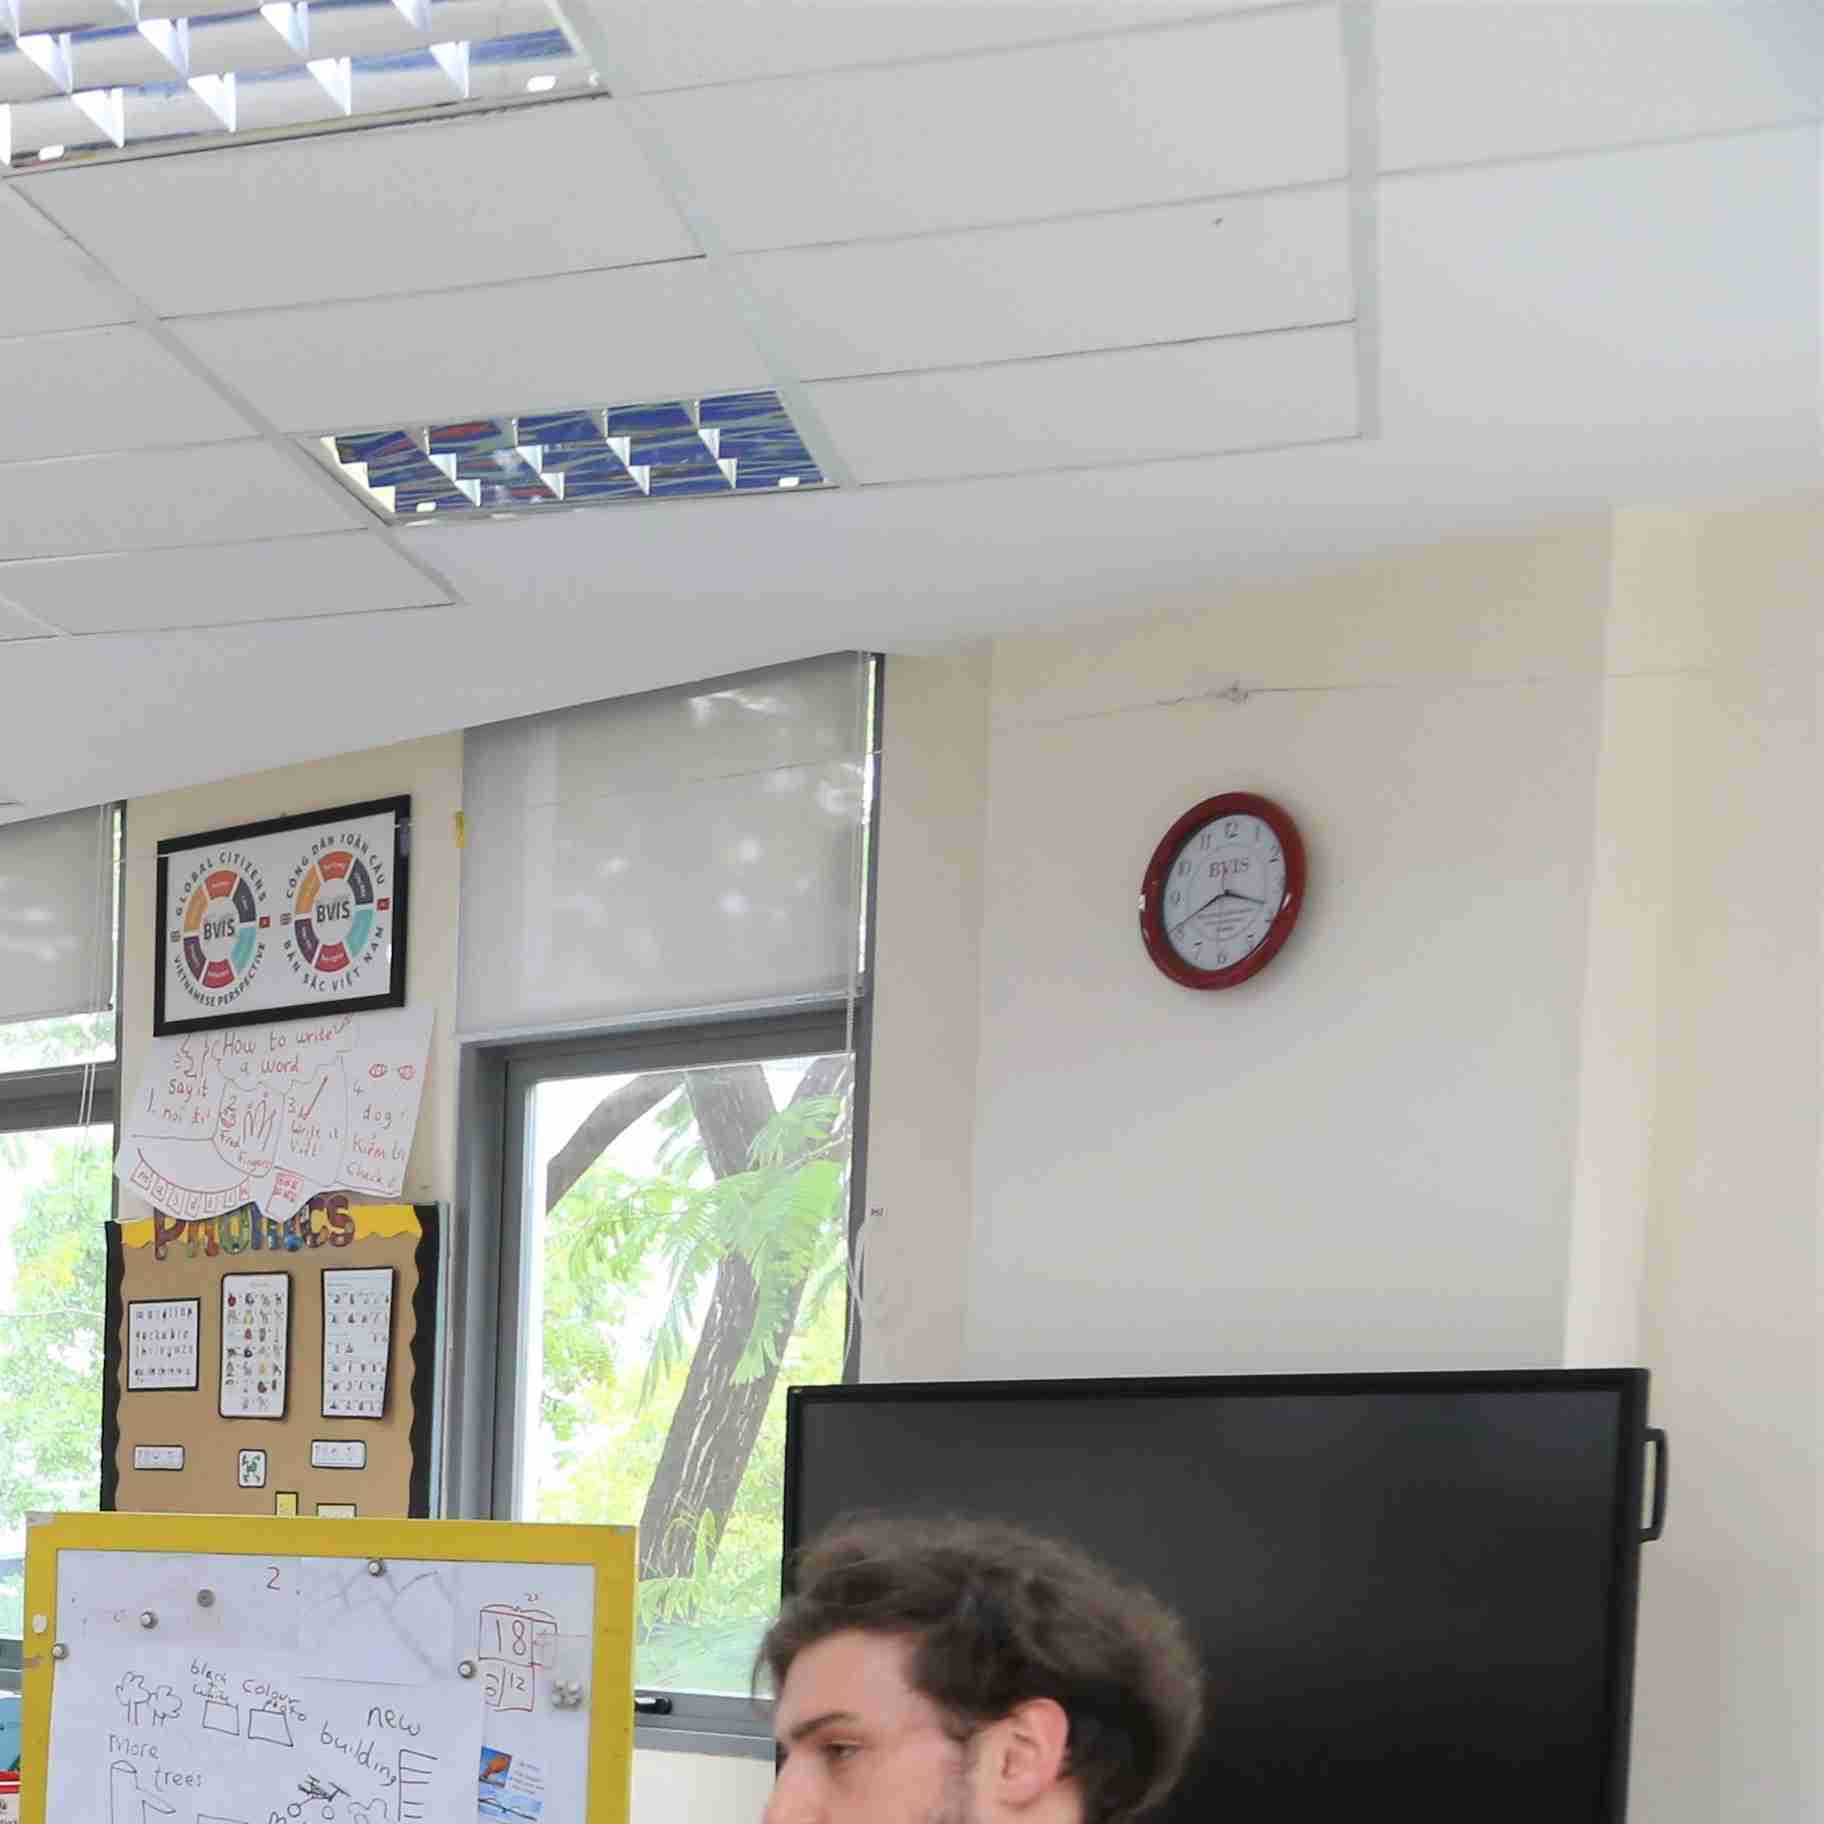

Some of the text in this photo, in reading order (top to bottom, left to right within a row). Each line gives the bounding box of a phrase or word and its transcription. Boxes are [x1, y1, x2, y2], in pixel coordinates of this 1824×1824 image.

[219, 851, 267, 902] CITIZENS
[316, 900, 350, 923] BVIS
[203, 918, 235, 941] BVIS
[223, 1029, 334, 1056] How to write
[239, 1055, 300, 1076] a word
[496, 1618, 527, 1656] 18
[368, 1707, 422, 1737] new
[153, 1765, 203, 1790] trees
